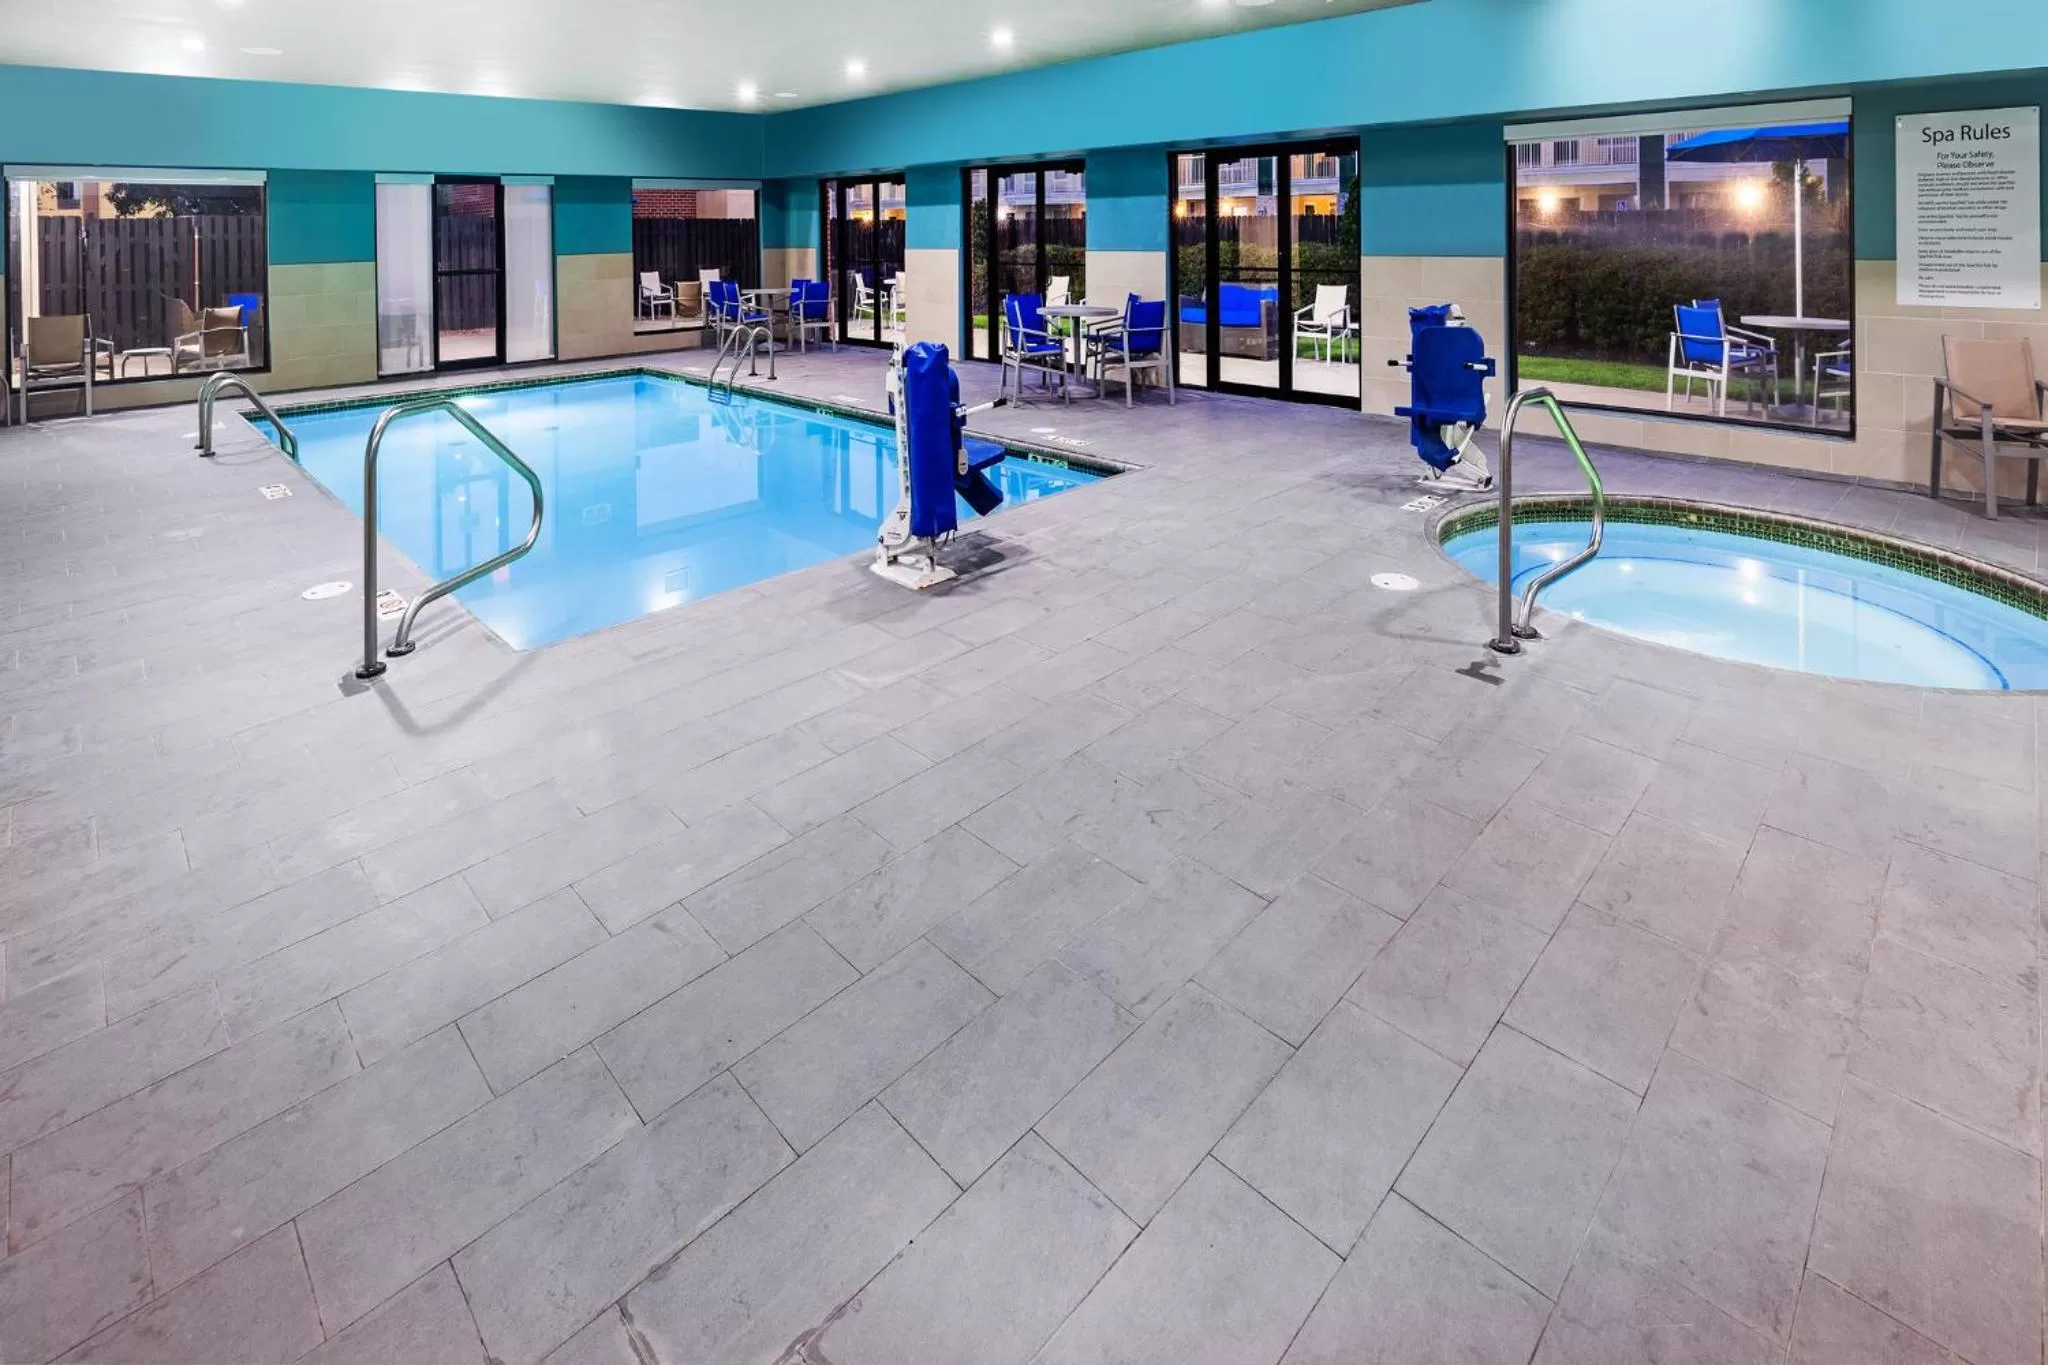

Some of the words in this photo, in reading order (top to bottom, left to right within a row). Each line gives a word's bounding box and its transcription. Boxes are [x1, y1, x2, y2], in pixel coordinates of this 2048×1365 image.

[1921, 126, 1955, 146] Spa
[1961, 123, 2011, 141] Rules
[1950, 151, 1967, 159] Your
[1937, 161, 1961, 169] Please
[1962, 160, 1995, 169] Observe
